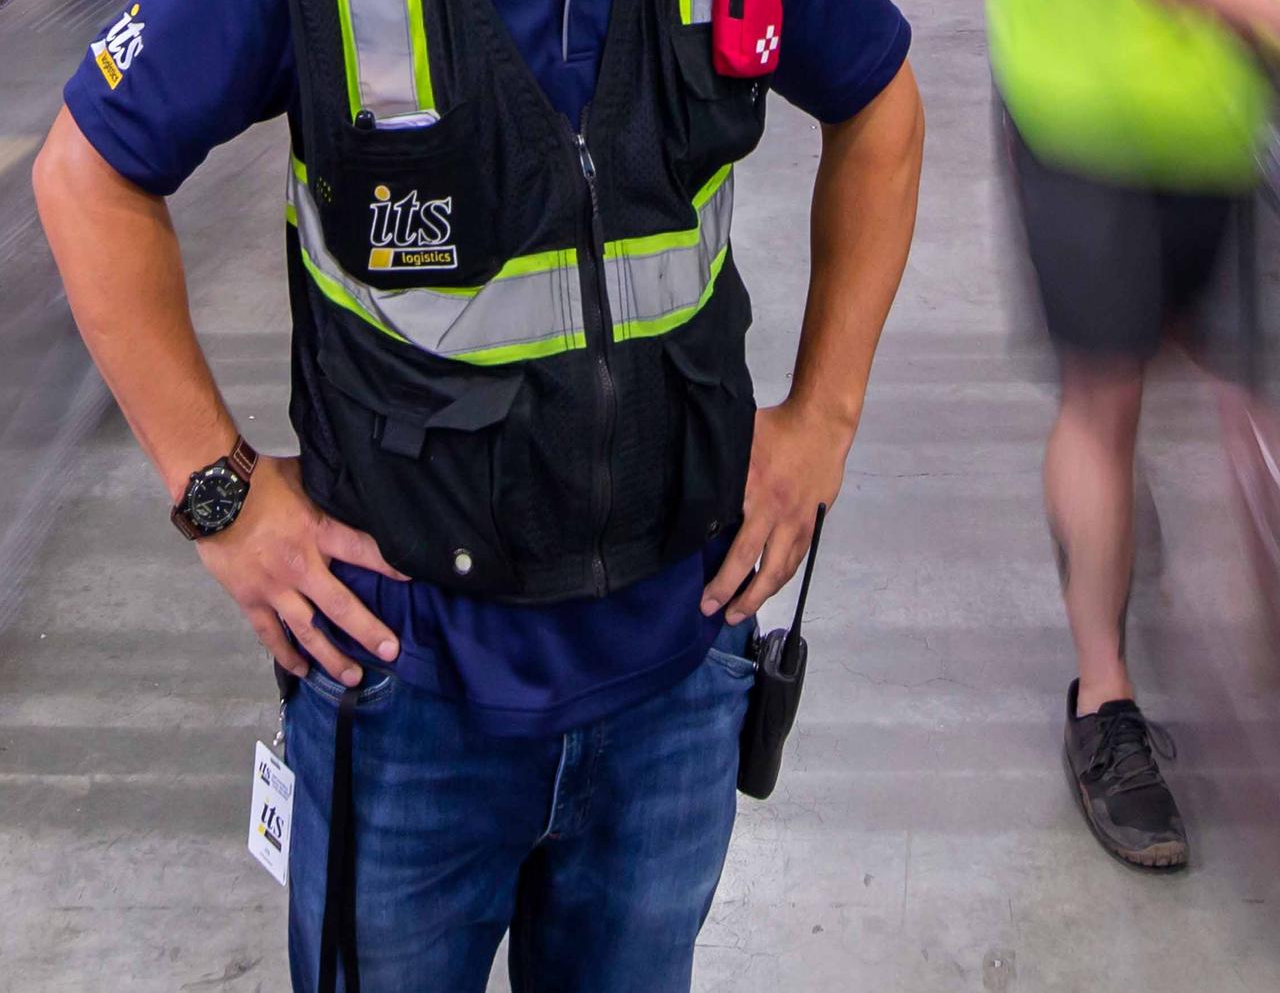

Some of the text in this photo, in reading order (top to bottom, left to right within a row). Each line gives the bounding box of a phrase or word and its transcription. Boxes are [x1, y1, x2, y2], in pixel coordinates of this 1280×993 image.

[105, 3, 146, 71] its
[369, 184, 453, 247] its
[401, 250, 452, 266] logistics
[260, 797, 284, 840] its
